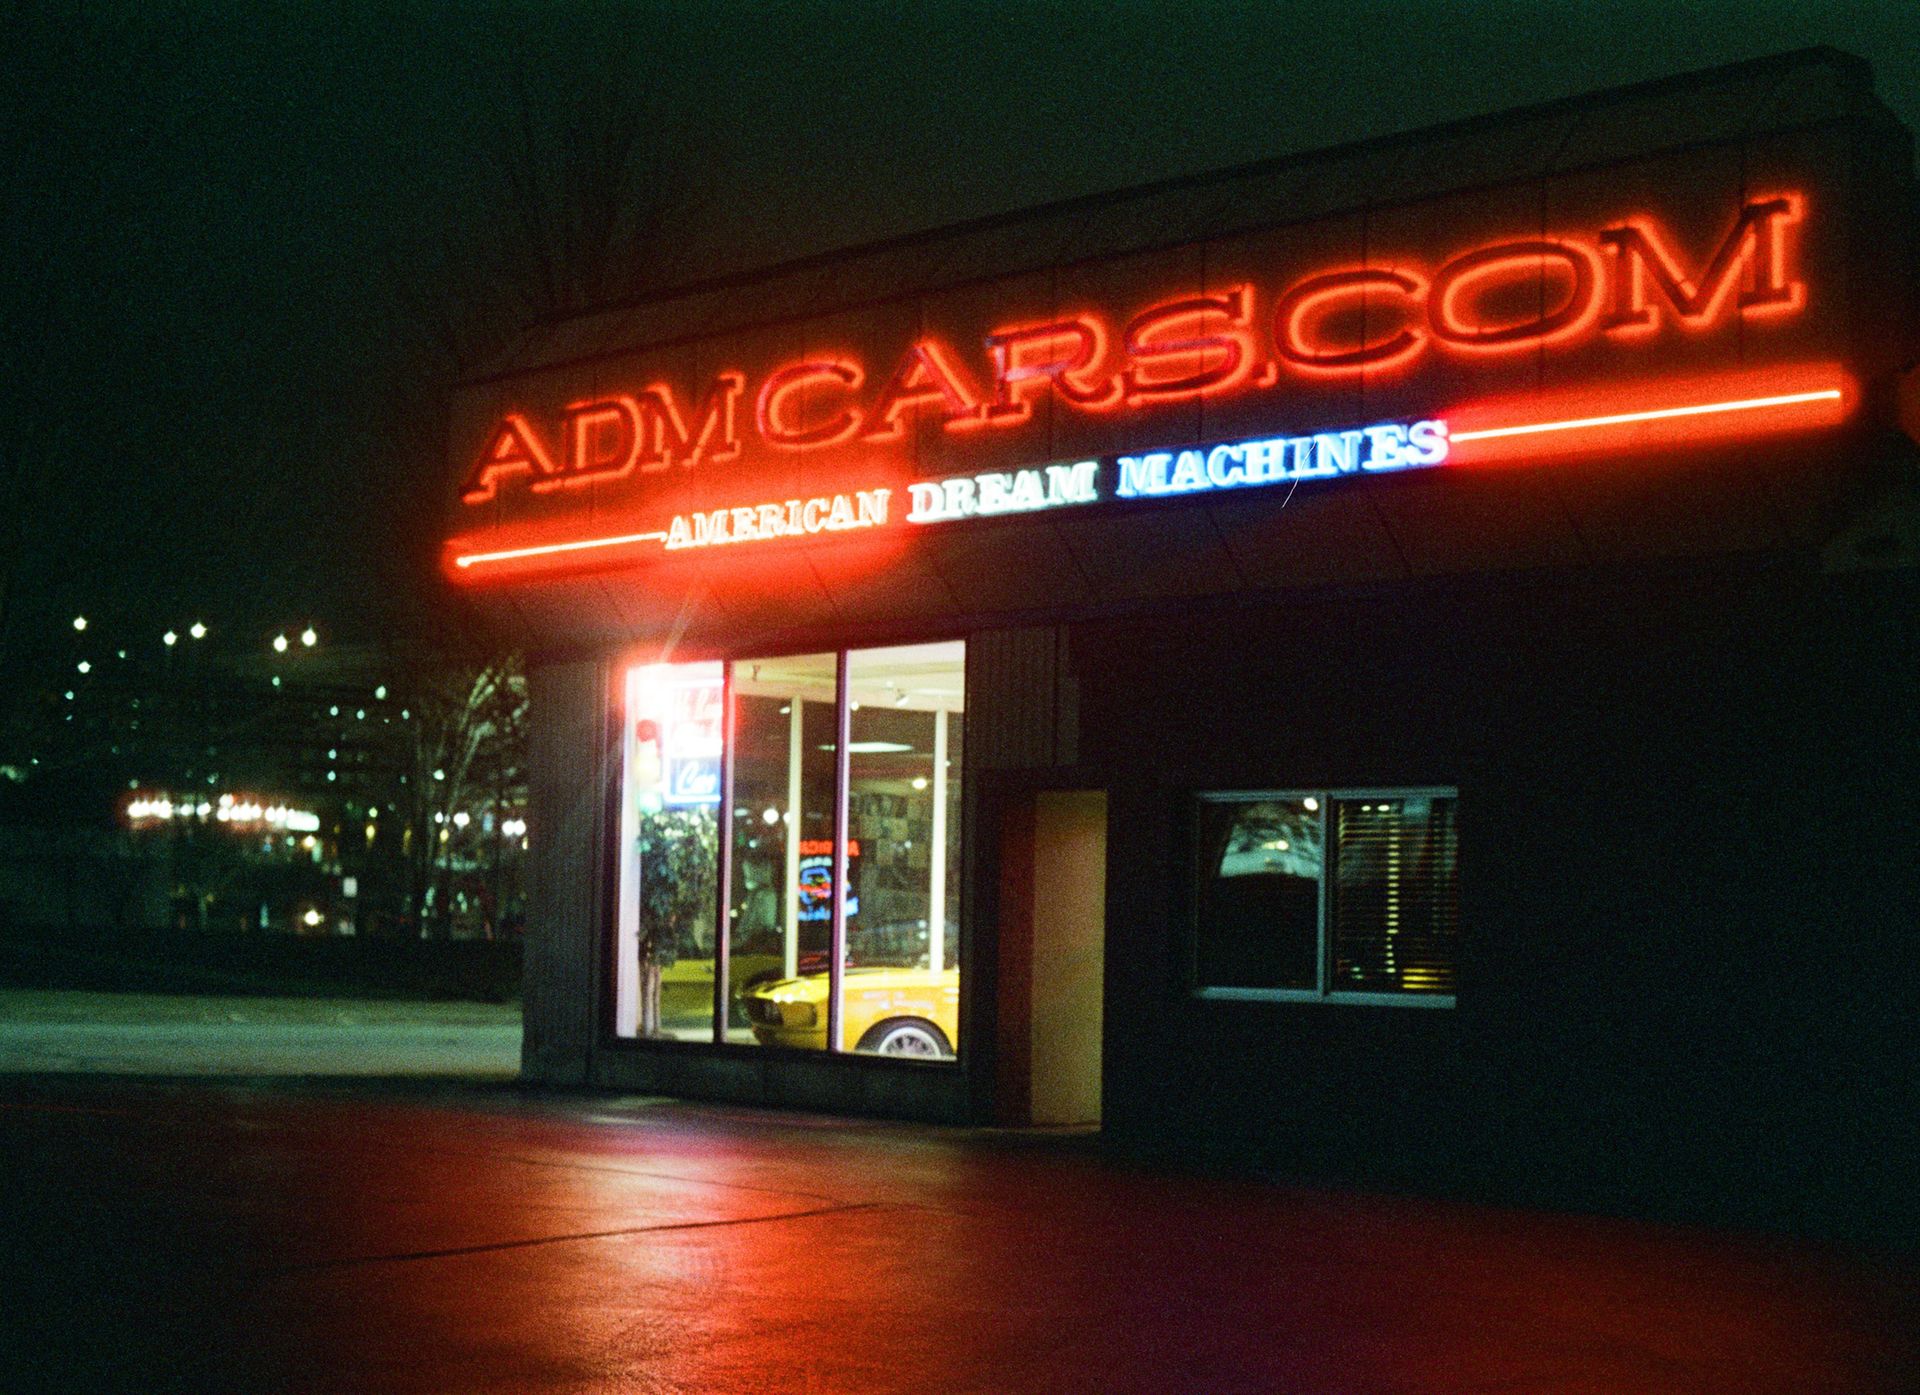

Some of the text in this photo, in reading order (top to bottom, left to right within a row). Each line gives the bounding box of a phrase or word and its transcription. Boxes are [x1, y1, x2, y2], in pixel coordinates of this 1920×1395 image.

[664, 420, 1450, 549] AMERICAN DREAM MACHINES
